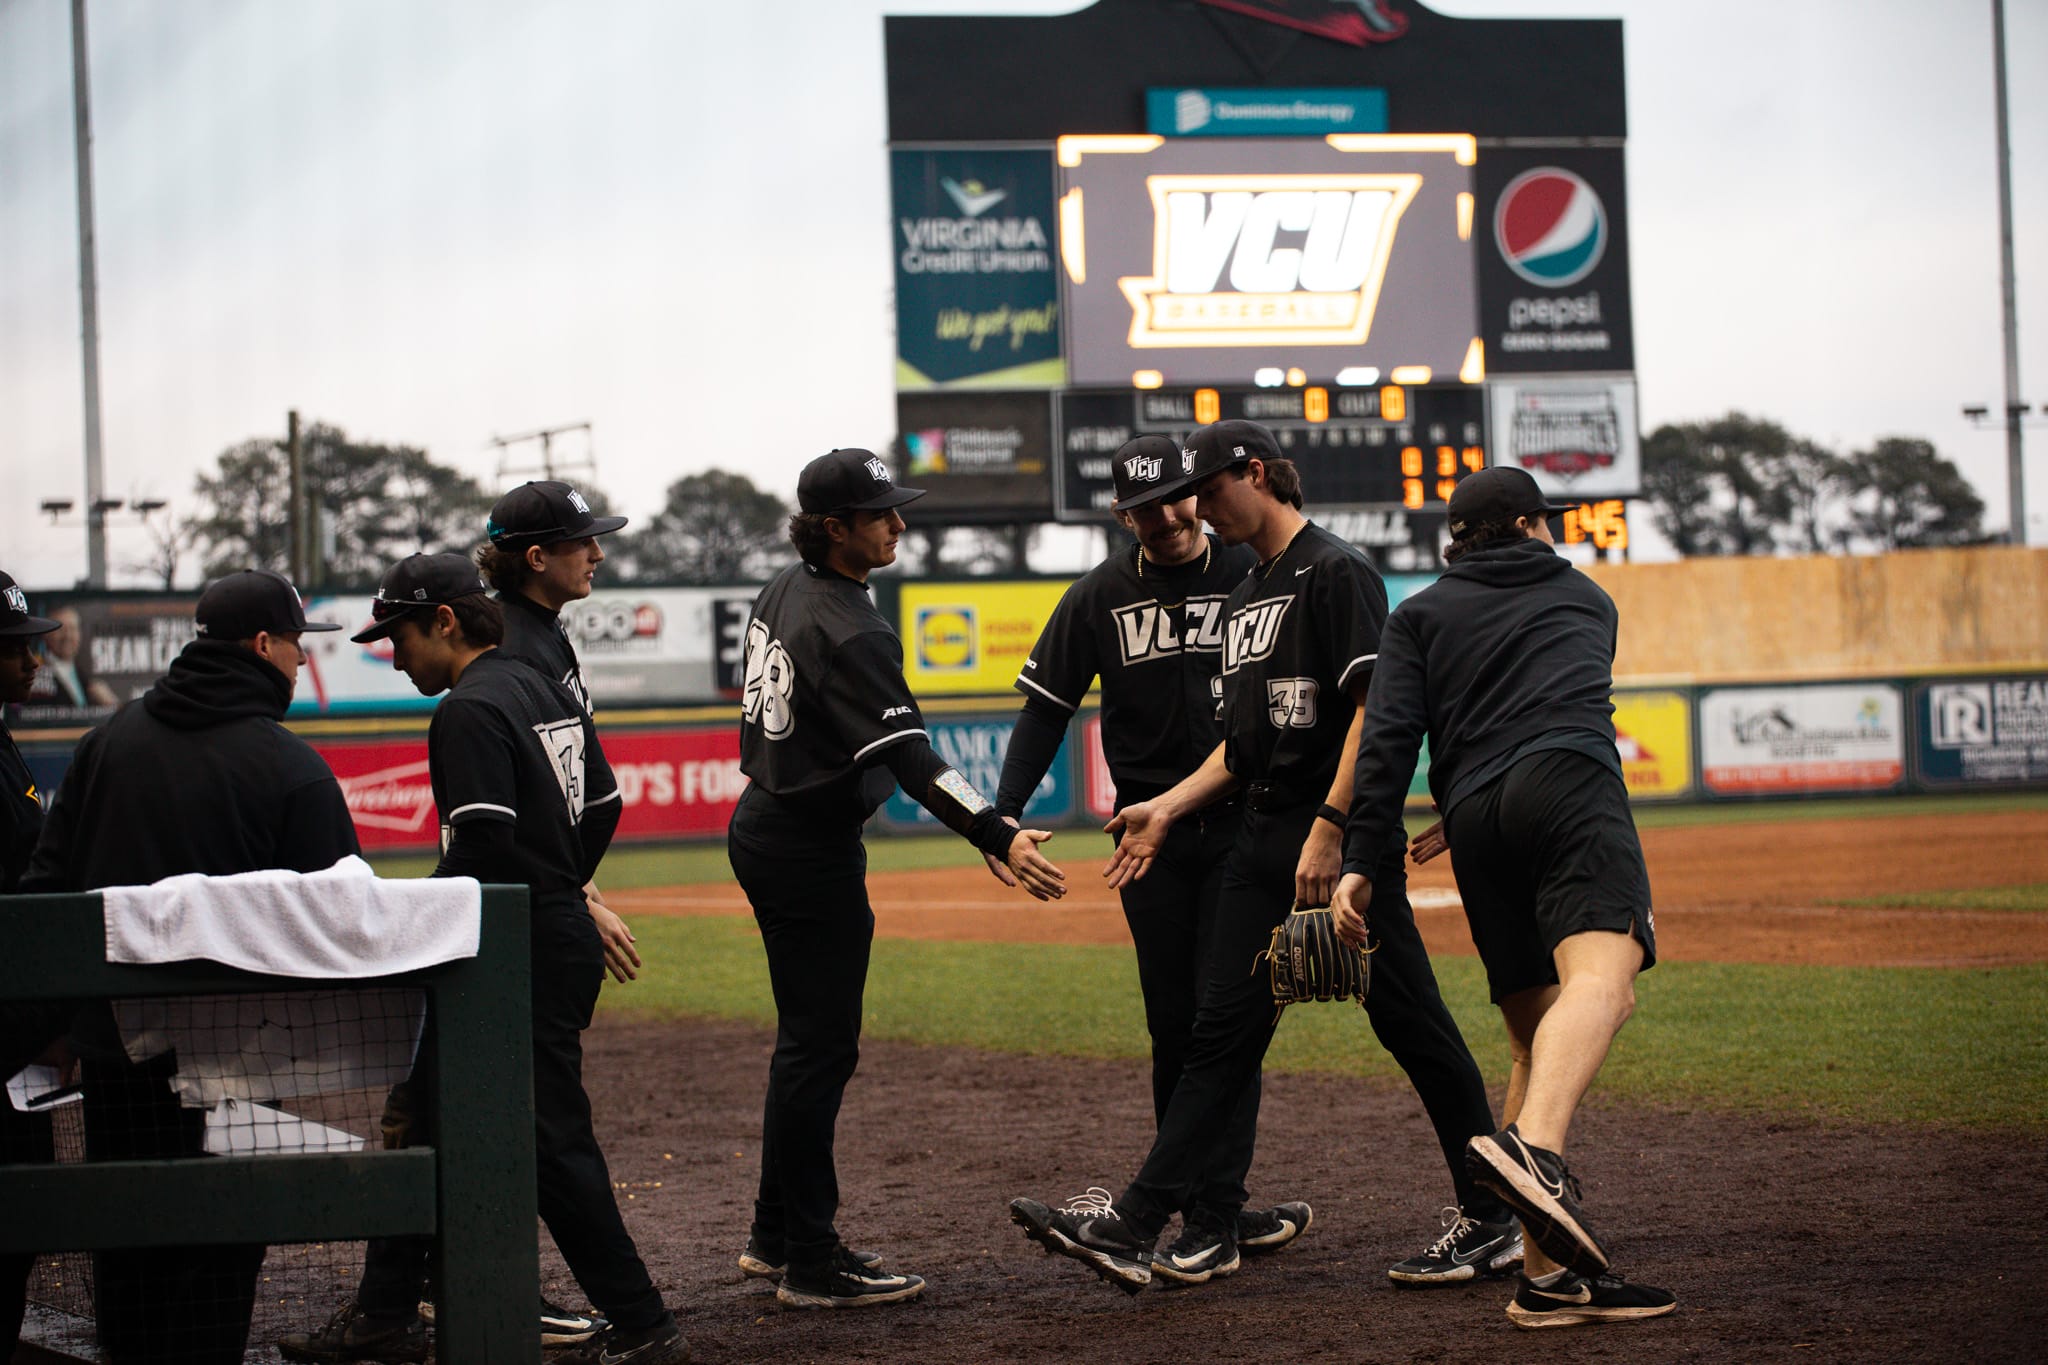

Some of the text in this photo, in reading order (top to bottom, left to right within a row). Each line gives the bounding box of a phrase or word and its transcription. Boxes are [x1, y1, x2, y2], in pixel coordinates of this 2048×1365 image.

[1293, 100, 1355, 122] Energy
[901, 217, 1048, 250] VIRGINIA
[1166, 190, 1394, 293] VCU
[901, 249, 976, 274] Credit
[1508, 290, 1601, 331] pepsi
[1146, 394, 1191, 419] BALL
[1194, 388, 1220, 424] 0
[1304, 386, 1329, 422] 0
[1380, 385, 1405, 421] 0
[1123, 455, 1163, 482] VCU
[1223, 594, 1296, 676] VCU
[742, 617, 795, 741] 28
[1994, 681, 2048, 709] REA
[1267, 677, 1320, 729] 39
